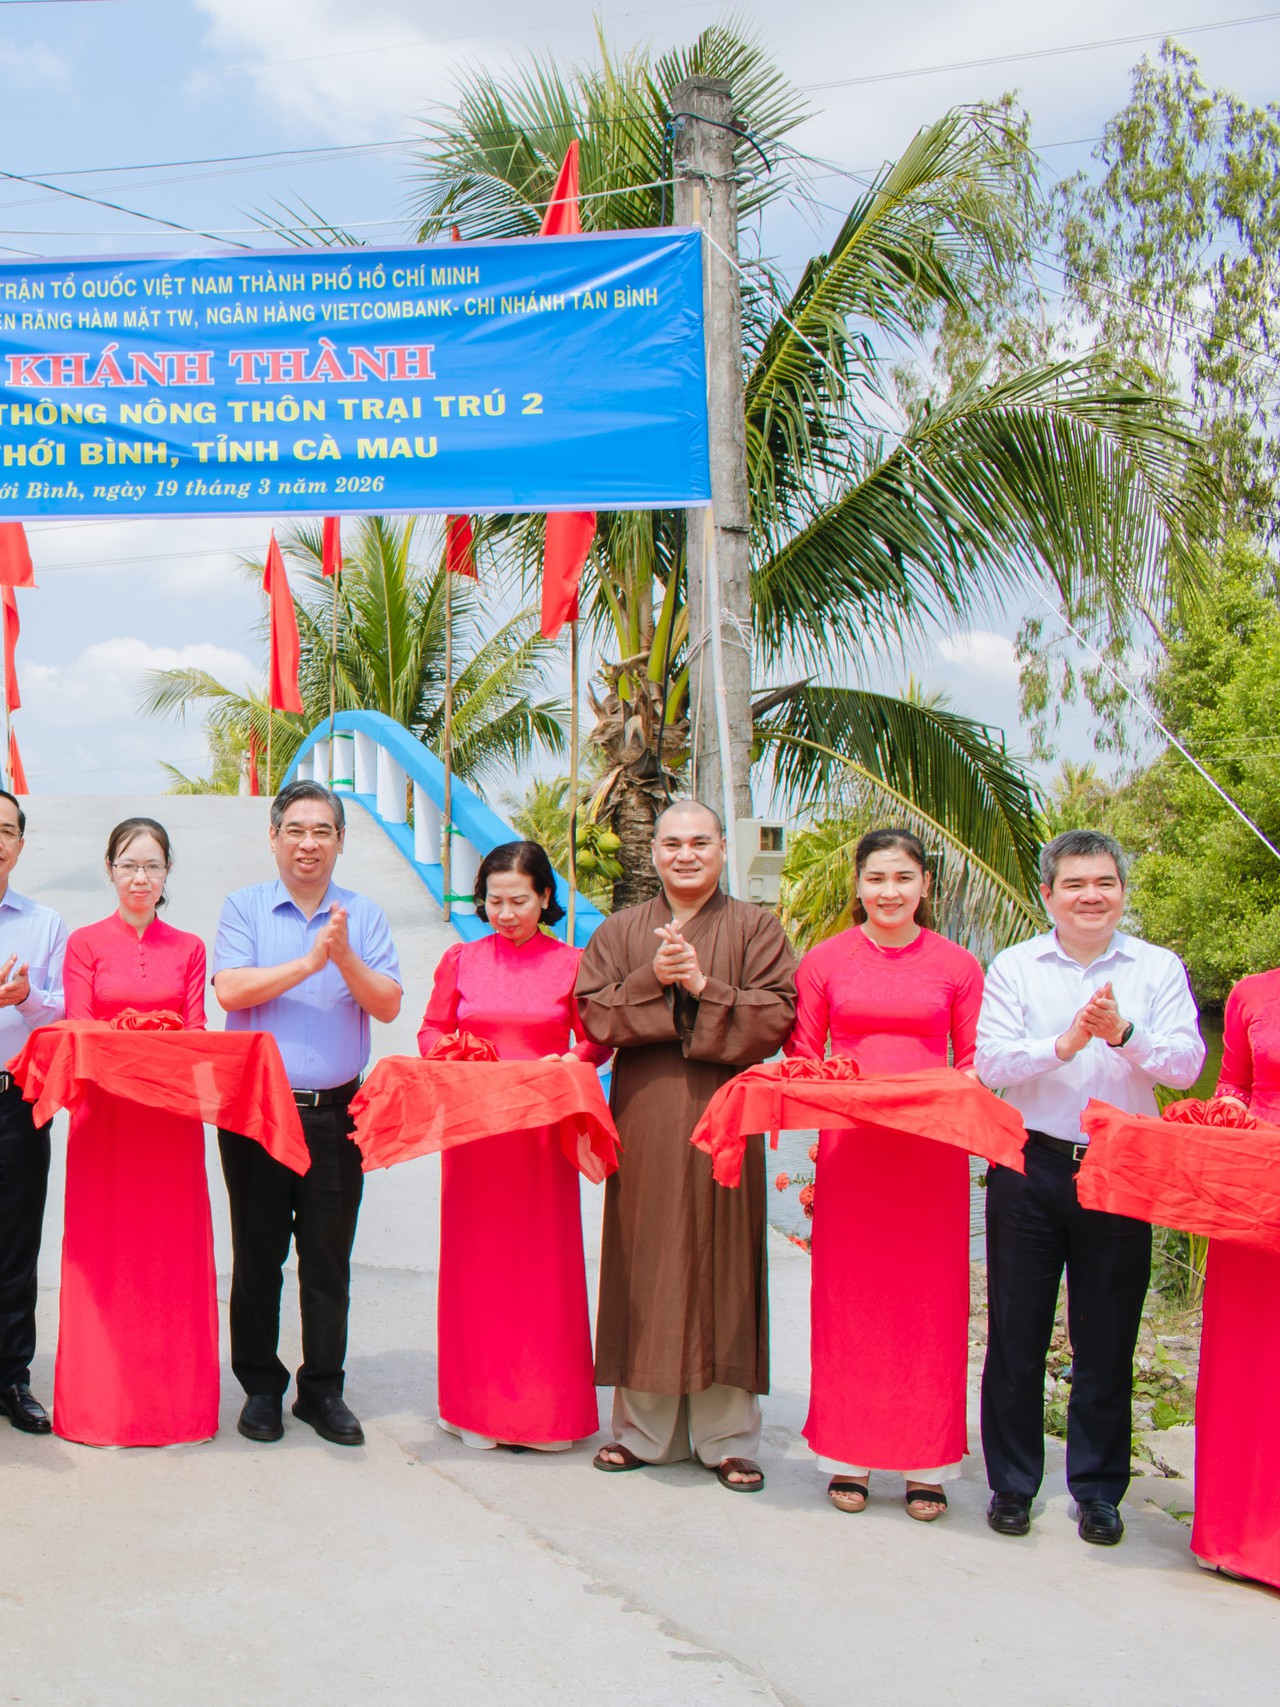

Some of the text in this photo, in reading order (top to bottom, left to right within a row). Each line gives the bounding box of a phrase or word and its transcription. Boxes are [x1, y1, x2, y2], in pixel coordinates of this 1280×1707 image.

[50, 272, 77, 299] TỔ
[81, 272, 137, 298] QUỐC
[143, 273, 185, 300] VIỆT
[191, 276, 233, 294] NAM
[239, 270, 305, 293] THÀNH
[312, 265, 353, 290] PHỐ
[358, 263, 386, 289] HỒ
[392, 265, 425, 288] CHÍ
[431, 267, 479, 286] MINH
[21, 307, 73, 331] RĂNG
[78, 306, 118, 329] HÀM
[123, 306, 161, 331] MẶT
[166, 309, 199, 330] TW,
[206, 301, 258, 325] NGÂN
[263, 301, 315, 322] HÀNG
[464, 298, 495, 316] CHI
[501, 291, 566, 315] NHÁNH
[569, 286, 608, 310] TÂN
[614, 284, 658, 308] BÌNH
[4, 342, 215, 389] KHÁNH
[228, 338, 436, 385] THÀNH
[119, 396, 217, 425] NÔNG
[227, 394, 326, 423] THÔN
[337, 397, 422, 424] TRẠI
[433, 388, 506, 418] TRÚ
[521, 393, 544, 415] 2
[80, 438, 179, 468] BÌNH,
[191, 434, 279, 463] TỈNH
[292, 434, 342, 461] CÀ
[356, 436, 438, 459] MAU
[26, 481, 84, 502] Bình,
[93, 482, 146, 502] ngày
[154, 480, 179, 498] 19
[185, 480, 251, 498] tháng
[258, 480, 271, 494] 3
[278, 480, 327, 494] năm
[335, 477, 385, 493] 2026
